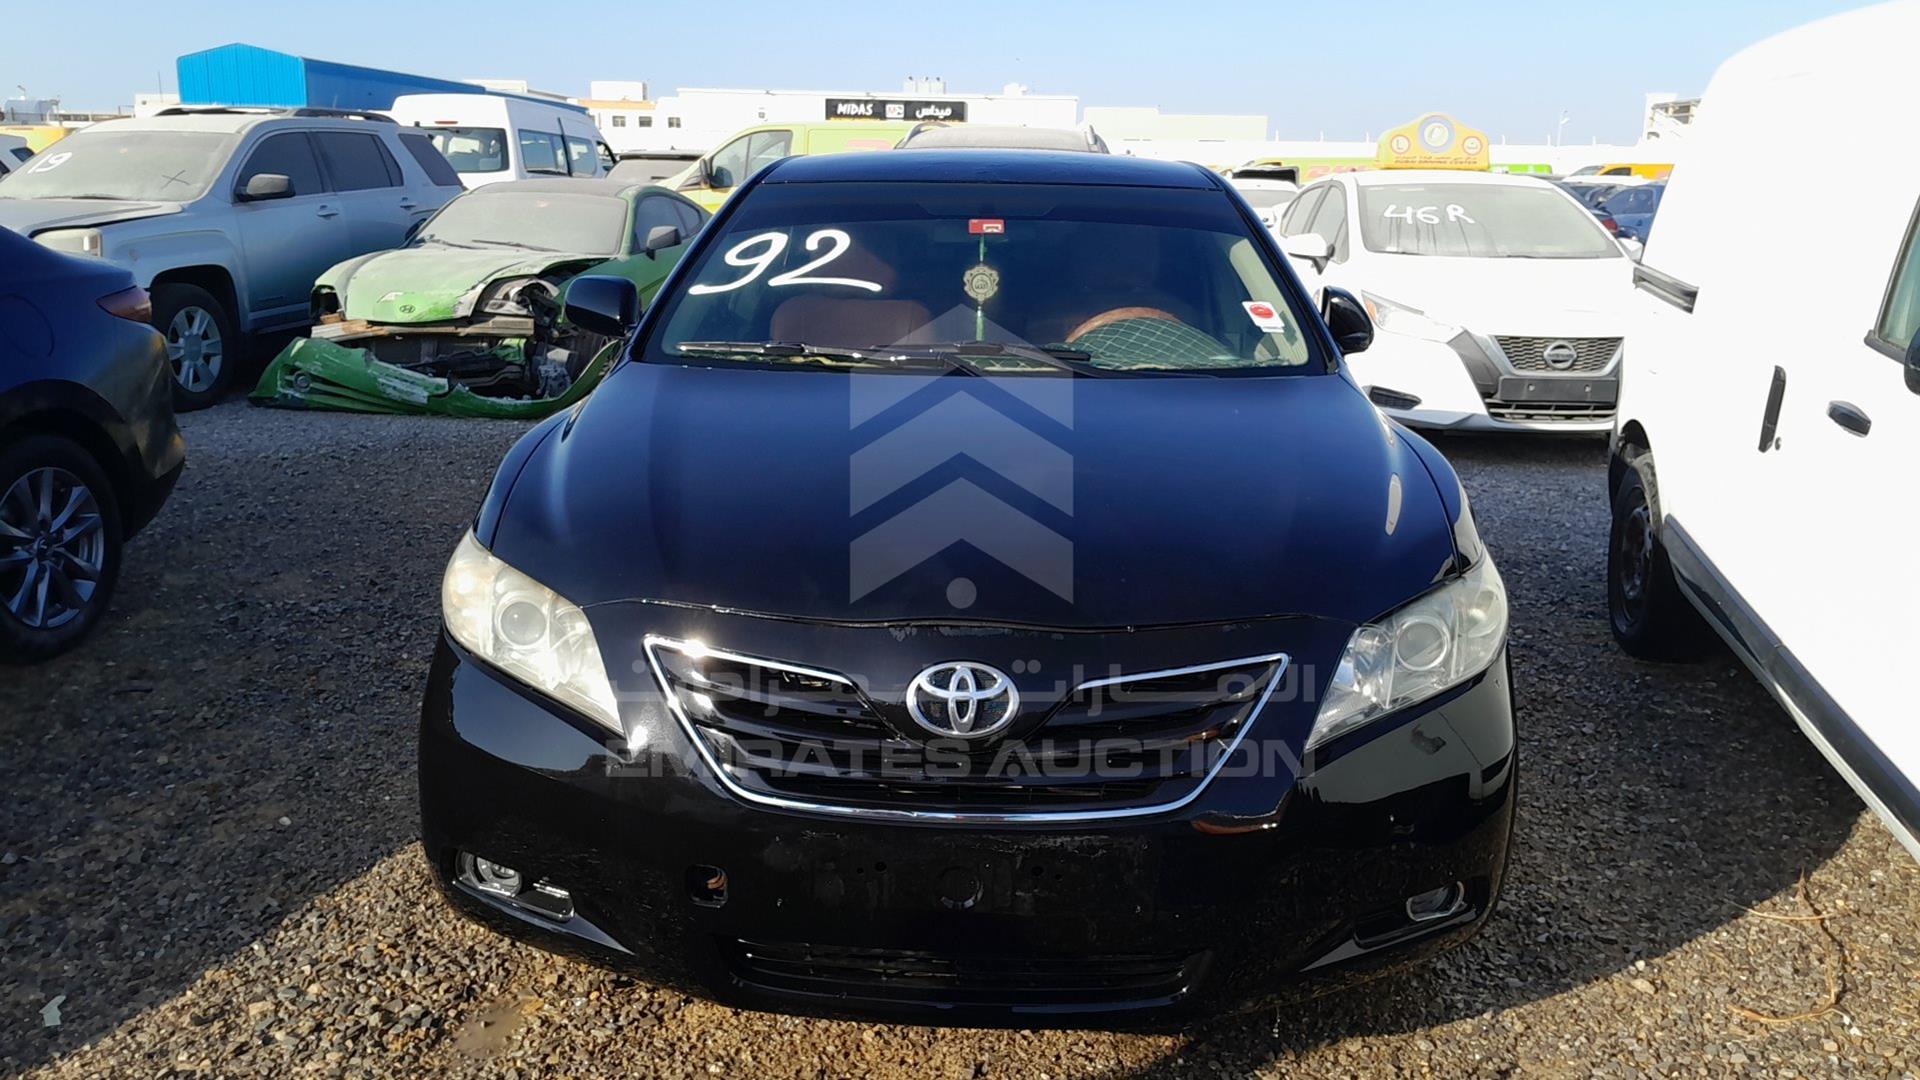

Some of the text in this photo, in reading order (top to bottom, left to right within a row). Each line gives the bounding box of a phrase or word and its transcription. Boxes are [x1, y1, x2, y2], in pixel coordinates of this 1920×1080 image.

[836, 104, 873, 115] MIDAS
[915, 104, 952, 118] ميداس
[27, 152, 72, 174] 19
[688, 229, 883, 296] 92
